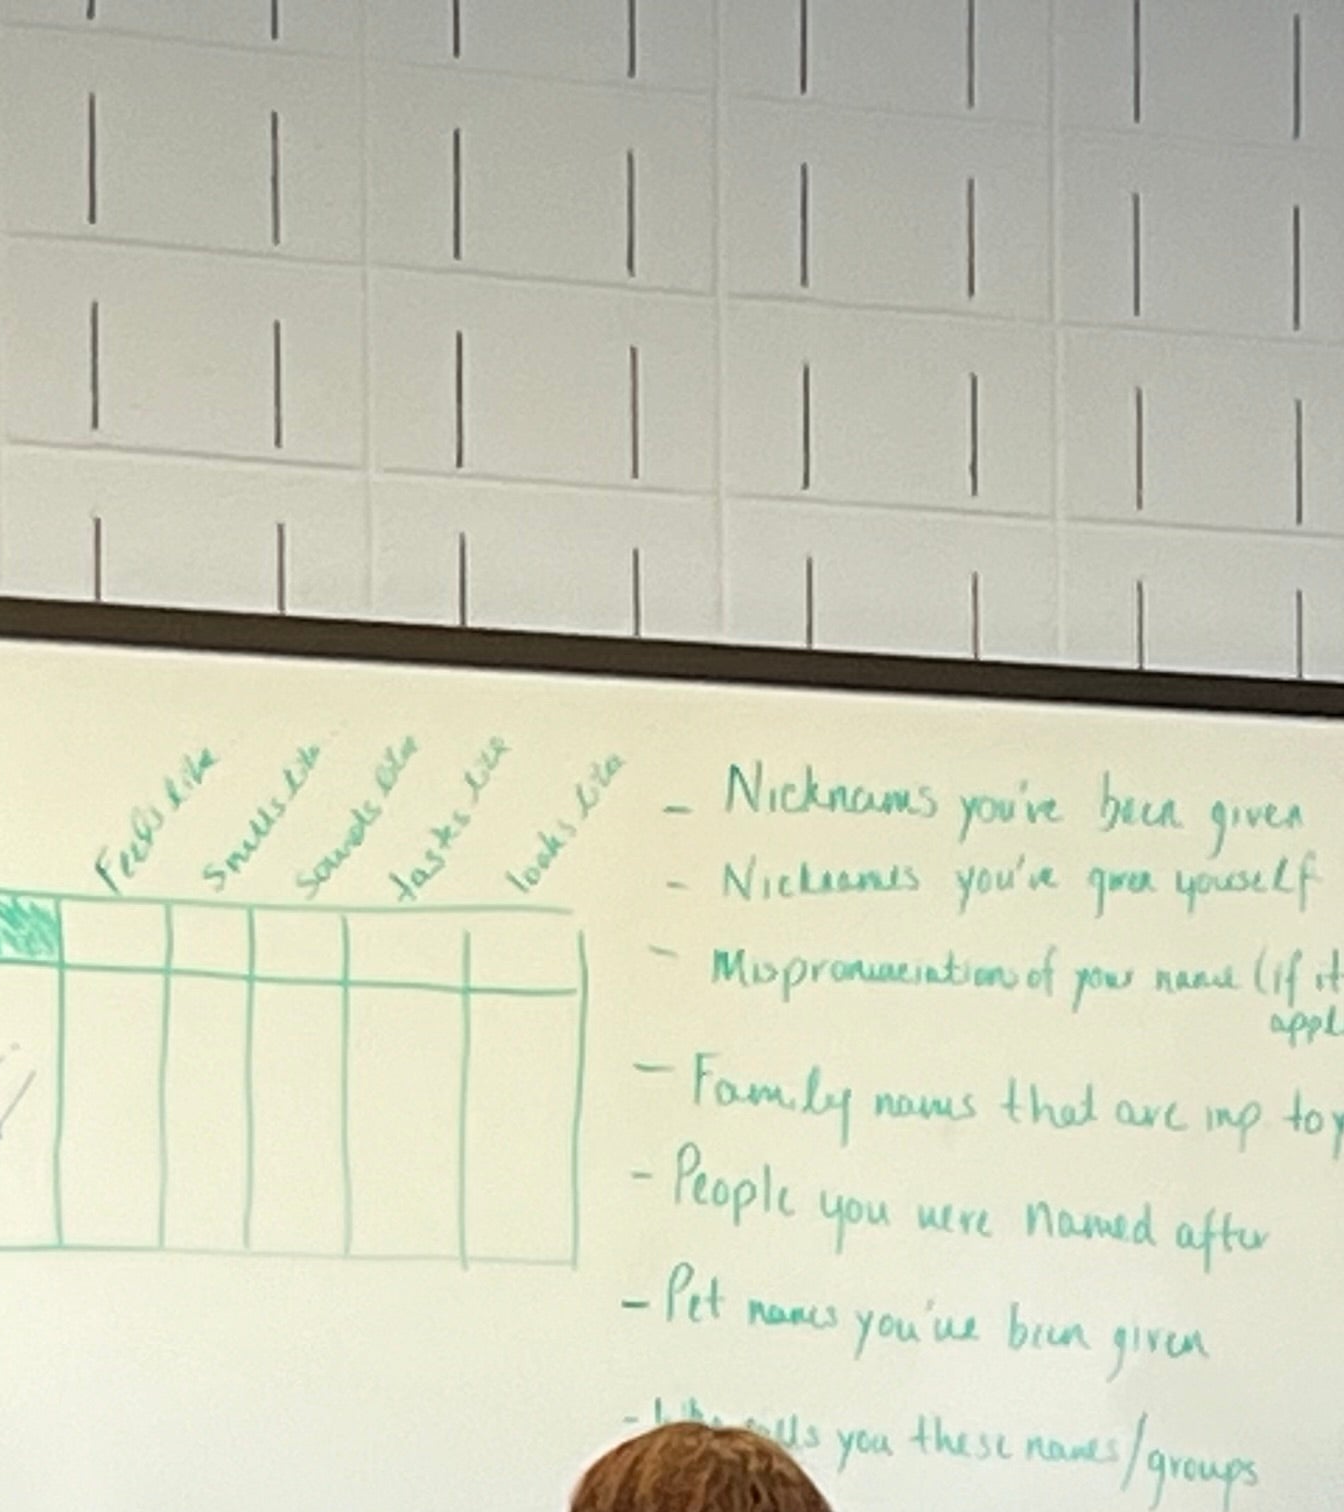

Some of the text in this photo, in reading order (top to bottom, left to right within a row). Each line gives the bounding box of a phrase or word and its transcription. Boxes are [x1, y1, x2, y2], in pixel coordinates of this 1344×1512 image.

[959, 779, 1063, 844] you've
[1100, 770, 1184, 832] been
[1210, 799, 1304, 860] given
[956, 854, 1059, 914] you've
[1027, 945, 1058, 998] of
[1072, 966, 1136, 1014] your
[693, 1052, 853, 1148] Family
[1001, 1076, 1098, 1129] that
[1115, 1099, 1188, 1133] are
[1283, 1088, 1324, 1135] to
[673, 1141, 796, 1228] People
[819, 1190, 891, 1255] you
[917, 1203, 994, 1238] were
[1175, 1207, 1271, 1275] after
[665, 1261, 725, 1323] Pet
[854, 1298, 981, 1361] you've
[1008, 1302, 1092, 1352] been
[1105, 1325, 1211, 1384] given
[836, 1429, 894, 1475] you
[909, 1413, 1014, 1460] these
